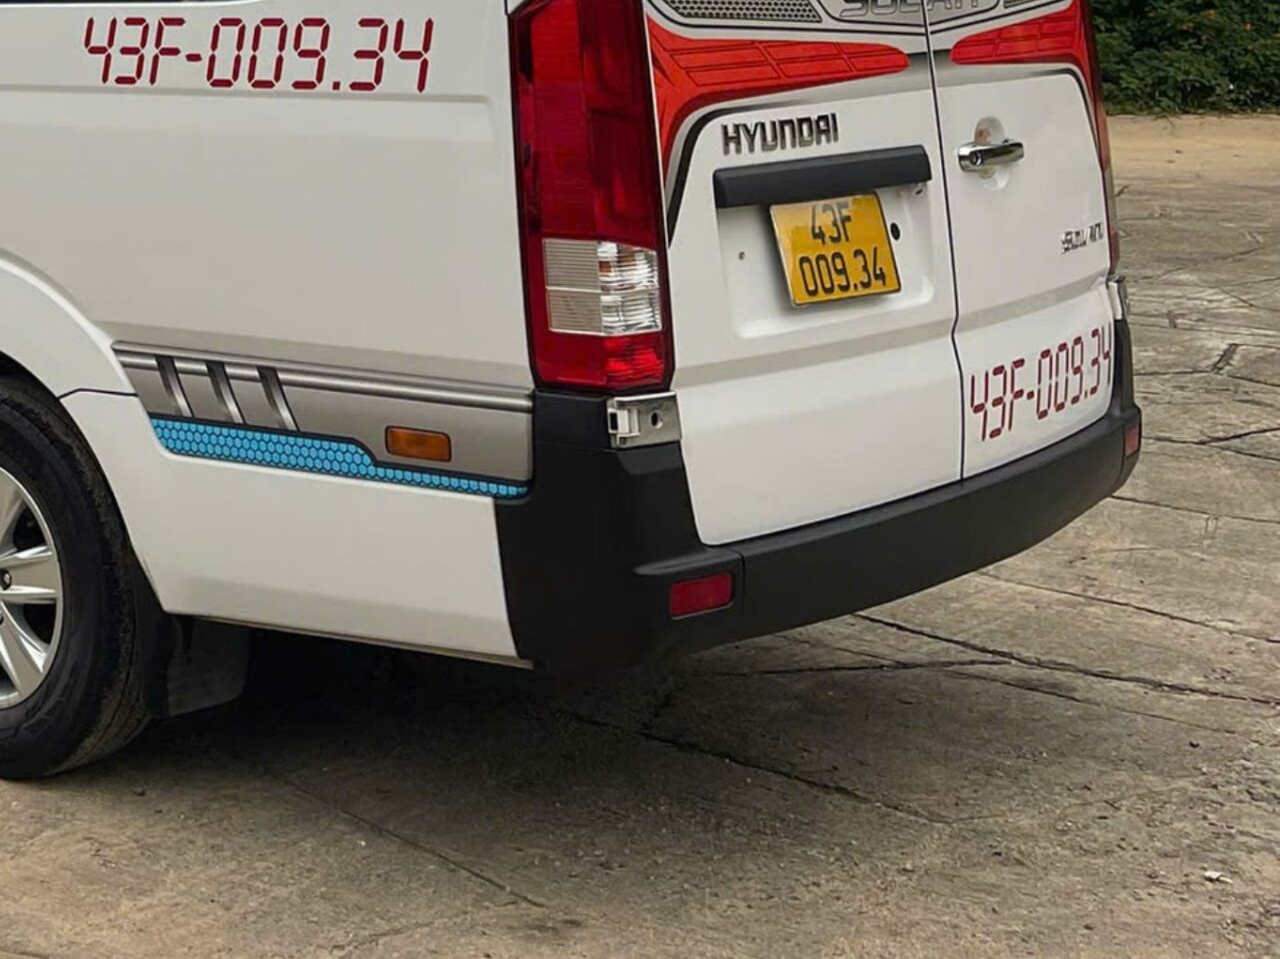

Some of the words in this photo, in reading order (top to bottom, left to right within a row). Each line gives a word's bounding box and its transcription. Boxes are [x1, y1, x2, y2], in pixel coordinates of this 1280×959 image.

[84, 17, 433, 93] 43F-009.34
[721, 112, 839, 156] HYUNDAI
[811, 202, 851, 245] 43F
[798, 246, 887, 297] 009.34
[970, 321, 1112, 441] 43F-009.34
